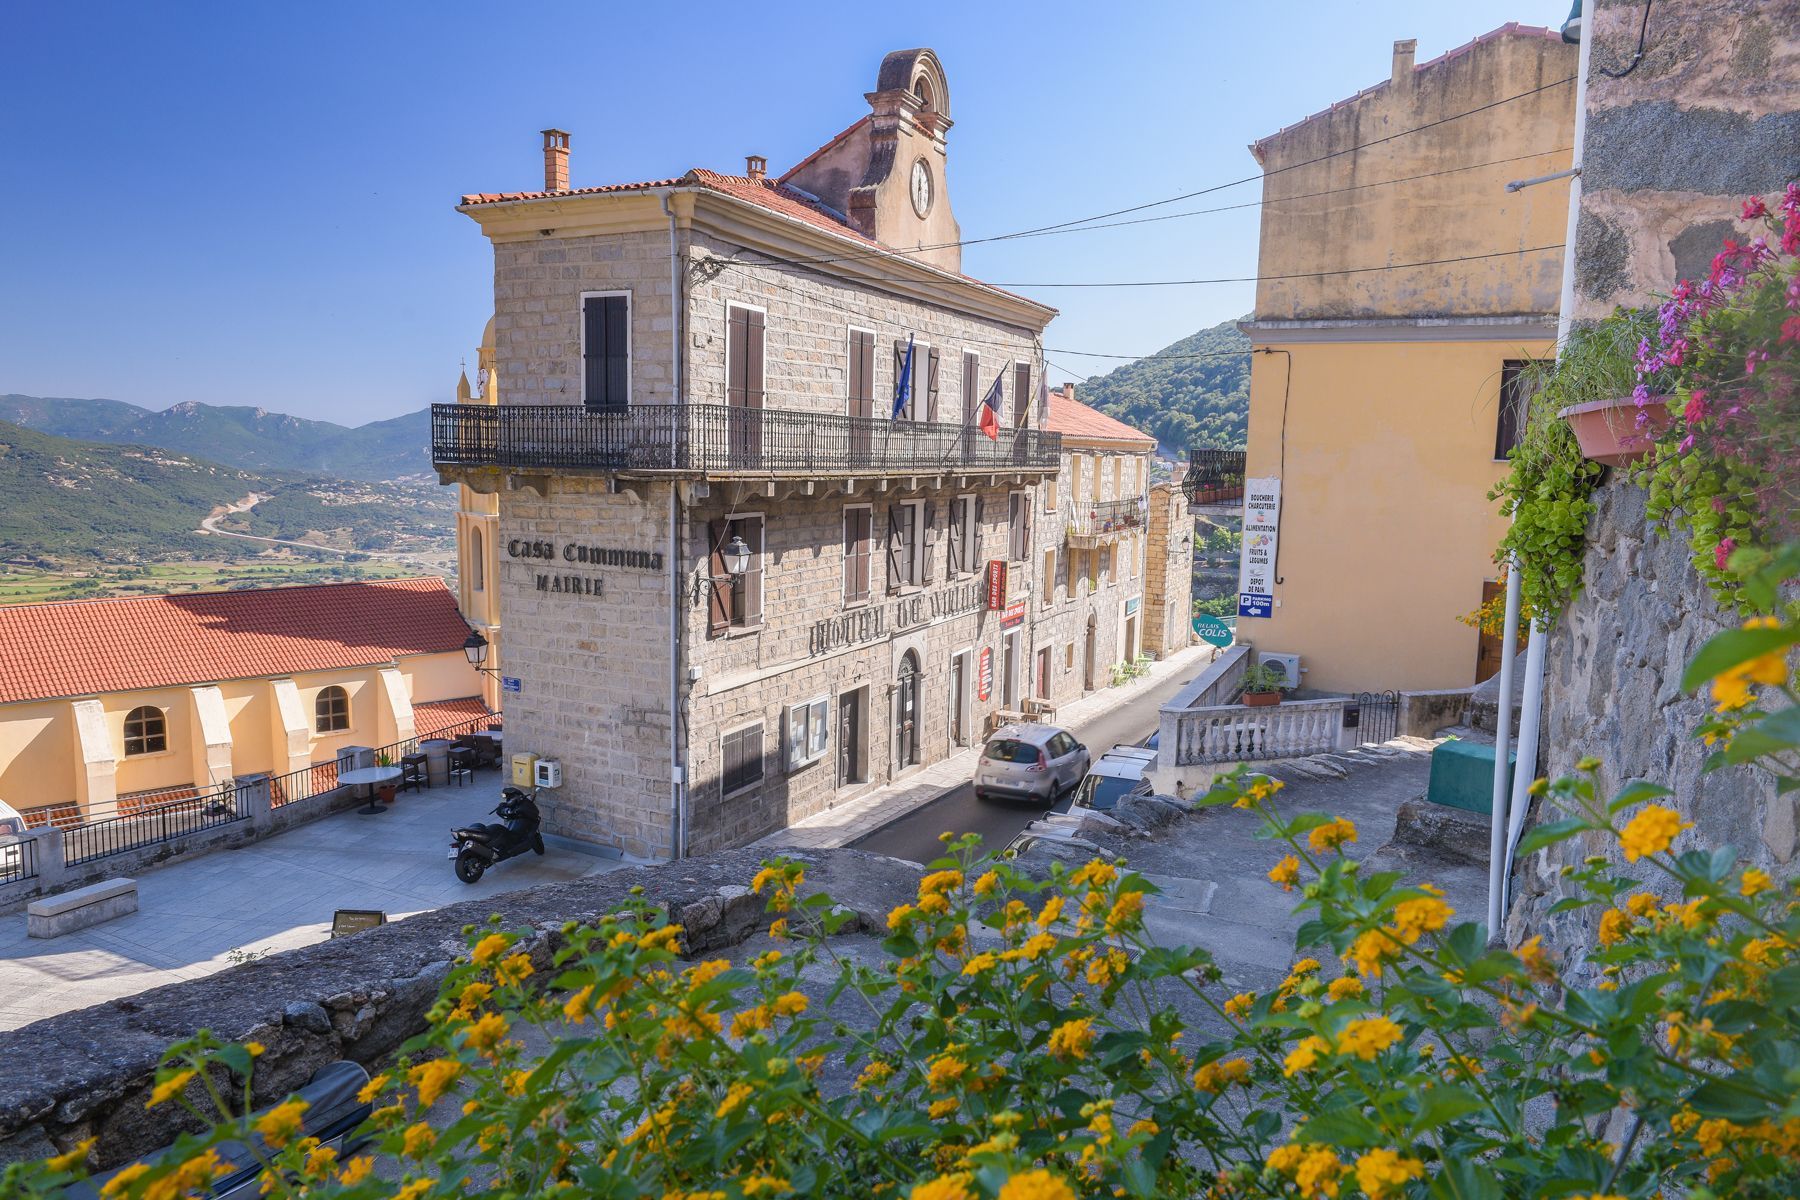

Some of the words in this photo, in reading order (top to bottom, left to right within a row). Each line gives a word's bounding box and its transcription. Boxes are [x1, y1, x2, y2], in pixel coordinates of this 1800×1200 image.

[1250, 494, 1274, 502] BOUCHERIE
[1248, 502, 1276, 510] CHARCUTERIE
[1246, 524, 1276, 532] ALIMENTATION
[508, 538, 554, 560] Casa
[563, 542, 663, 570] Cummuna
[1249, 548, 1264, 556] FRUITS
[536, 574, 604, 596] MAIRIE
[897, 599, 922, 628] DE
[1199, 628, 1228, 638] COLIS
